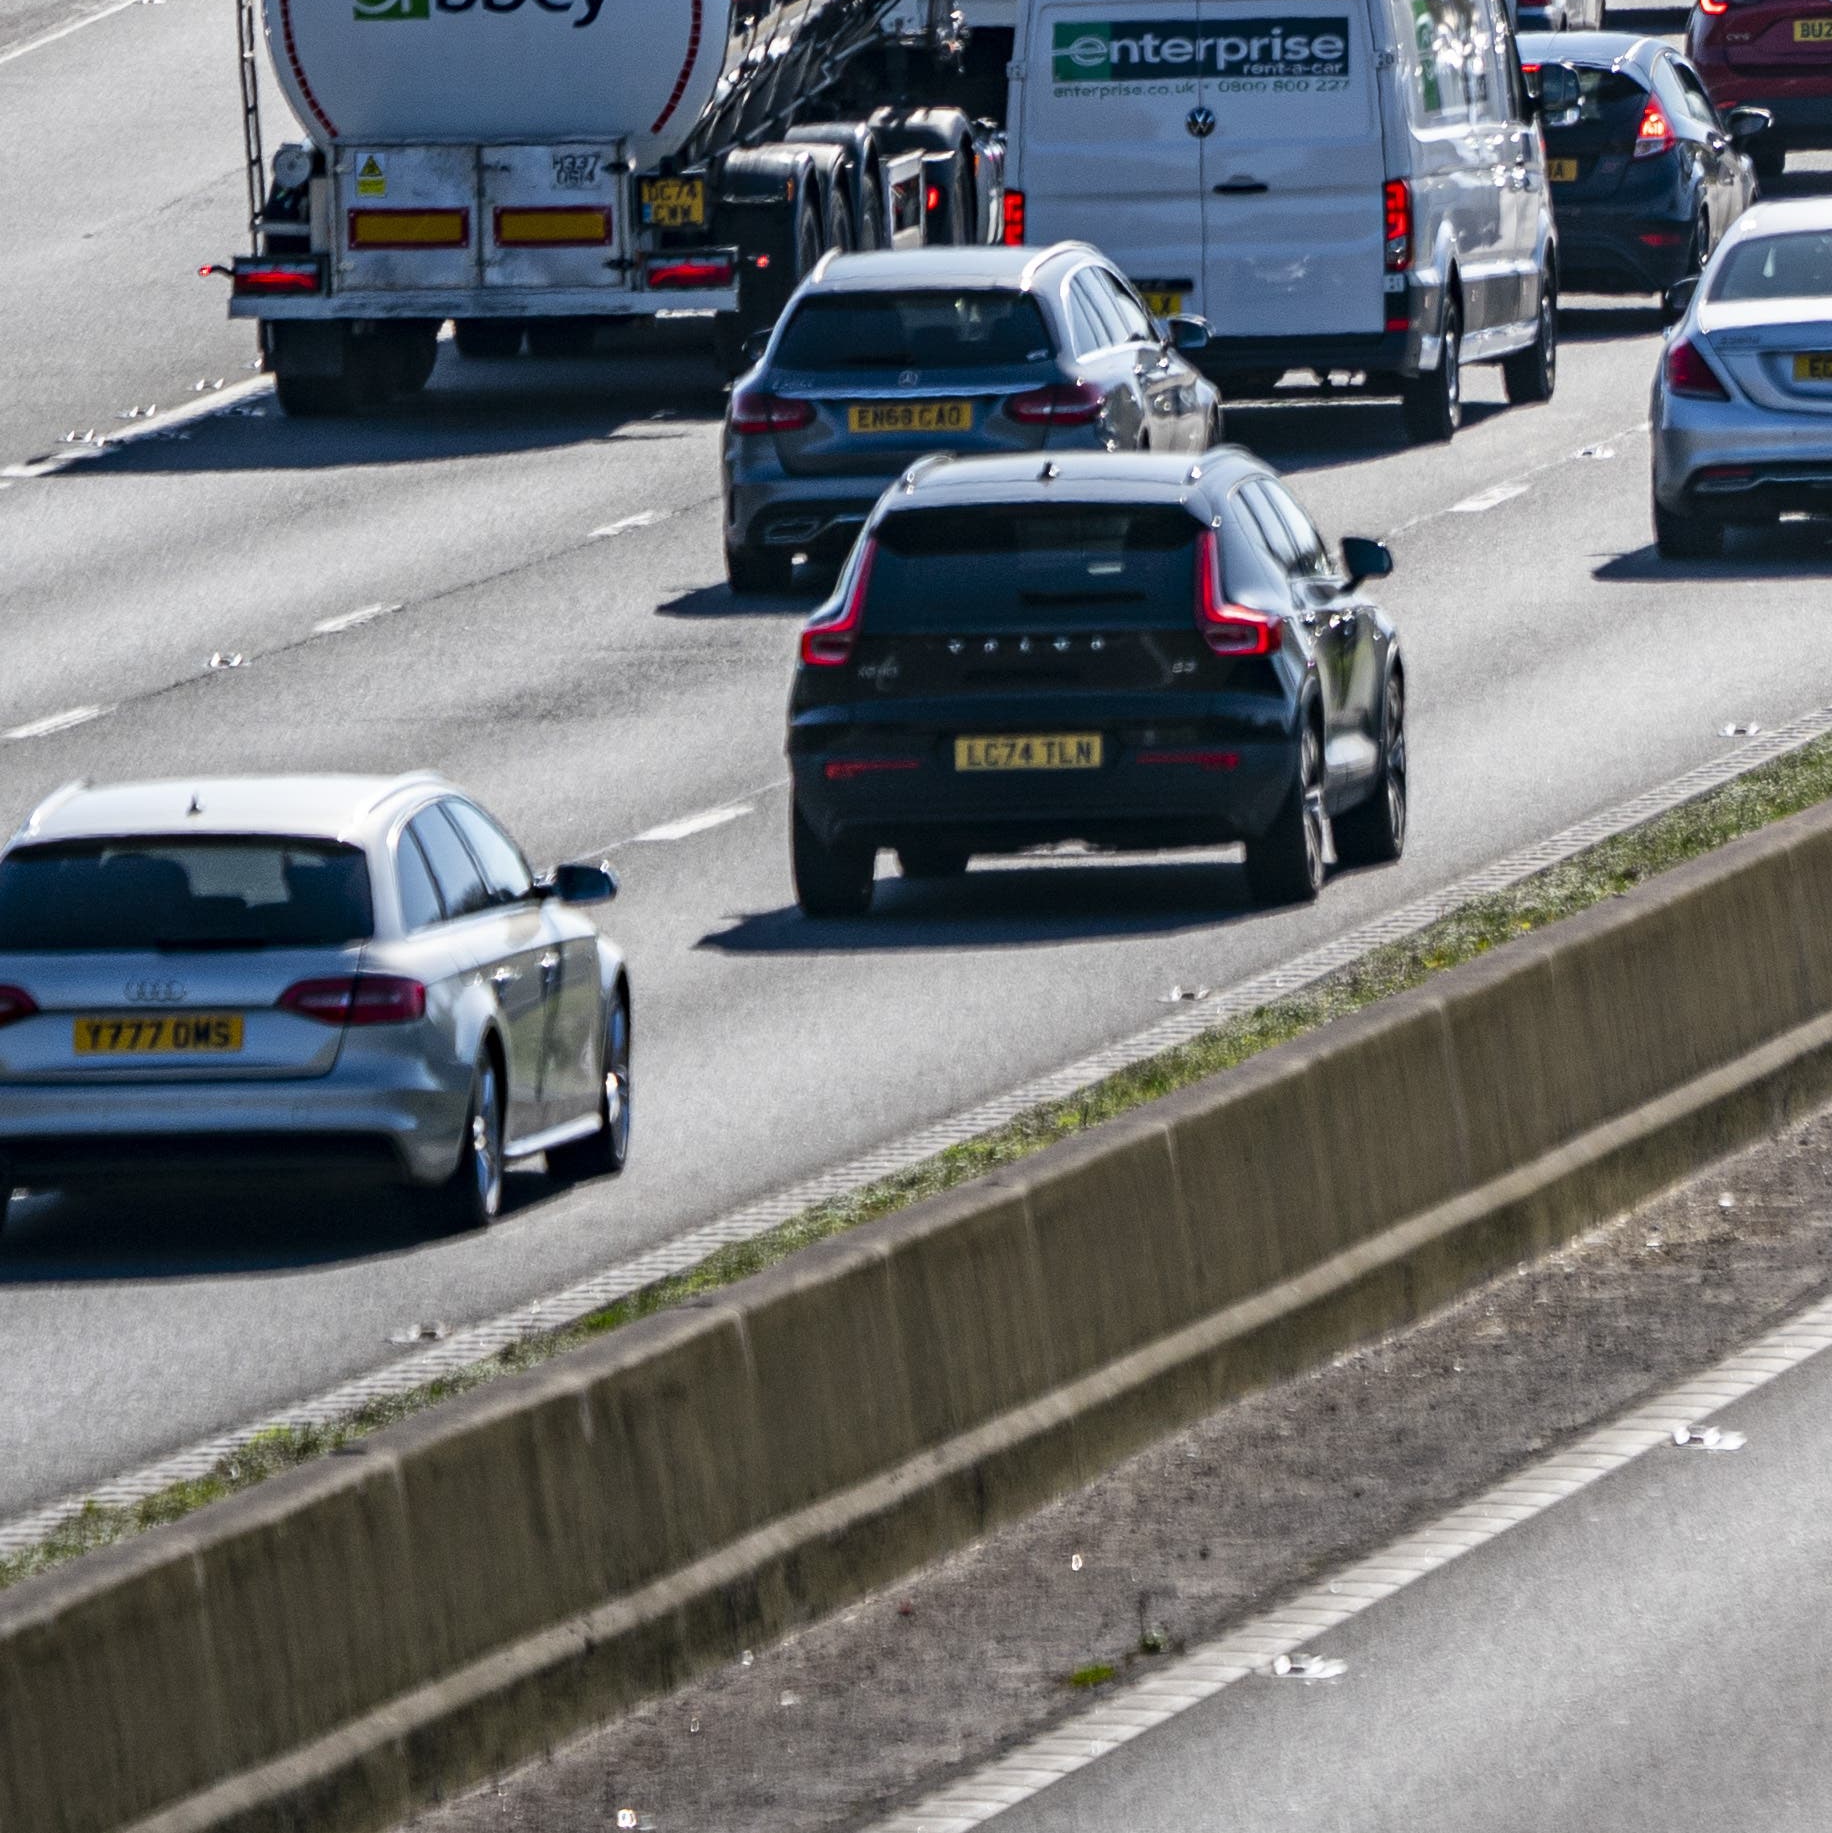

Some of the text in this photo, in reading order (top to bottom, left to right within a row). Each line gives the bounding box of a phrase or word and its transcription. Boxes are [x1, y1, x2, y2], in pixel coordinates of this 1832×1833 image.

[1068, 28, 1345, 77] enterprise
[1241, 61, 1344, 76] rent-a-car
[1052, 77, 1352, 99] enterprise.co.uk 0800 800 227
[967, 740, 1093, 768] LC74 TLN
